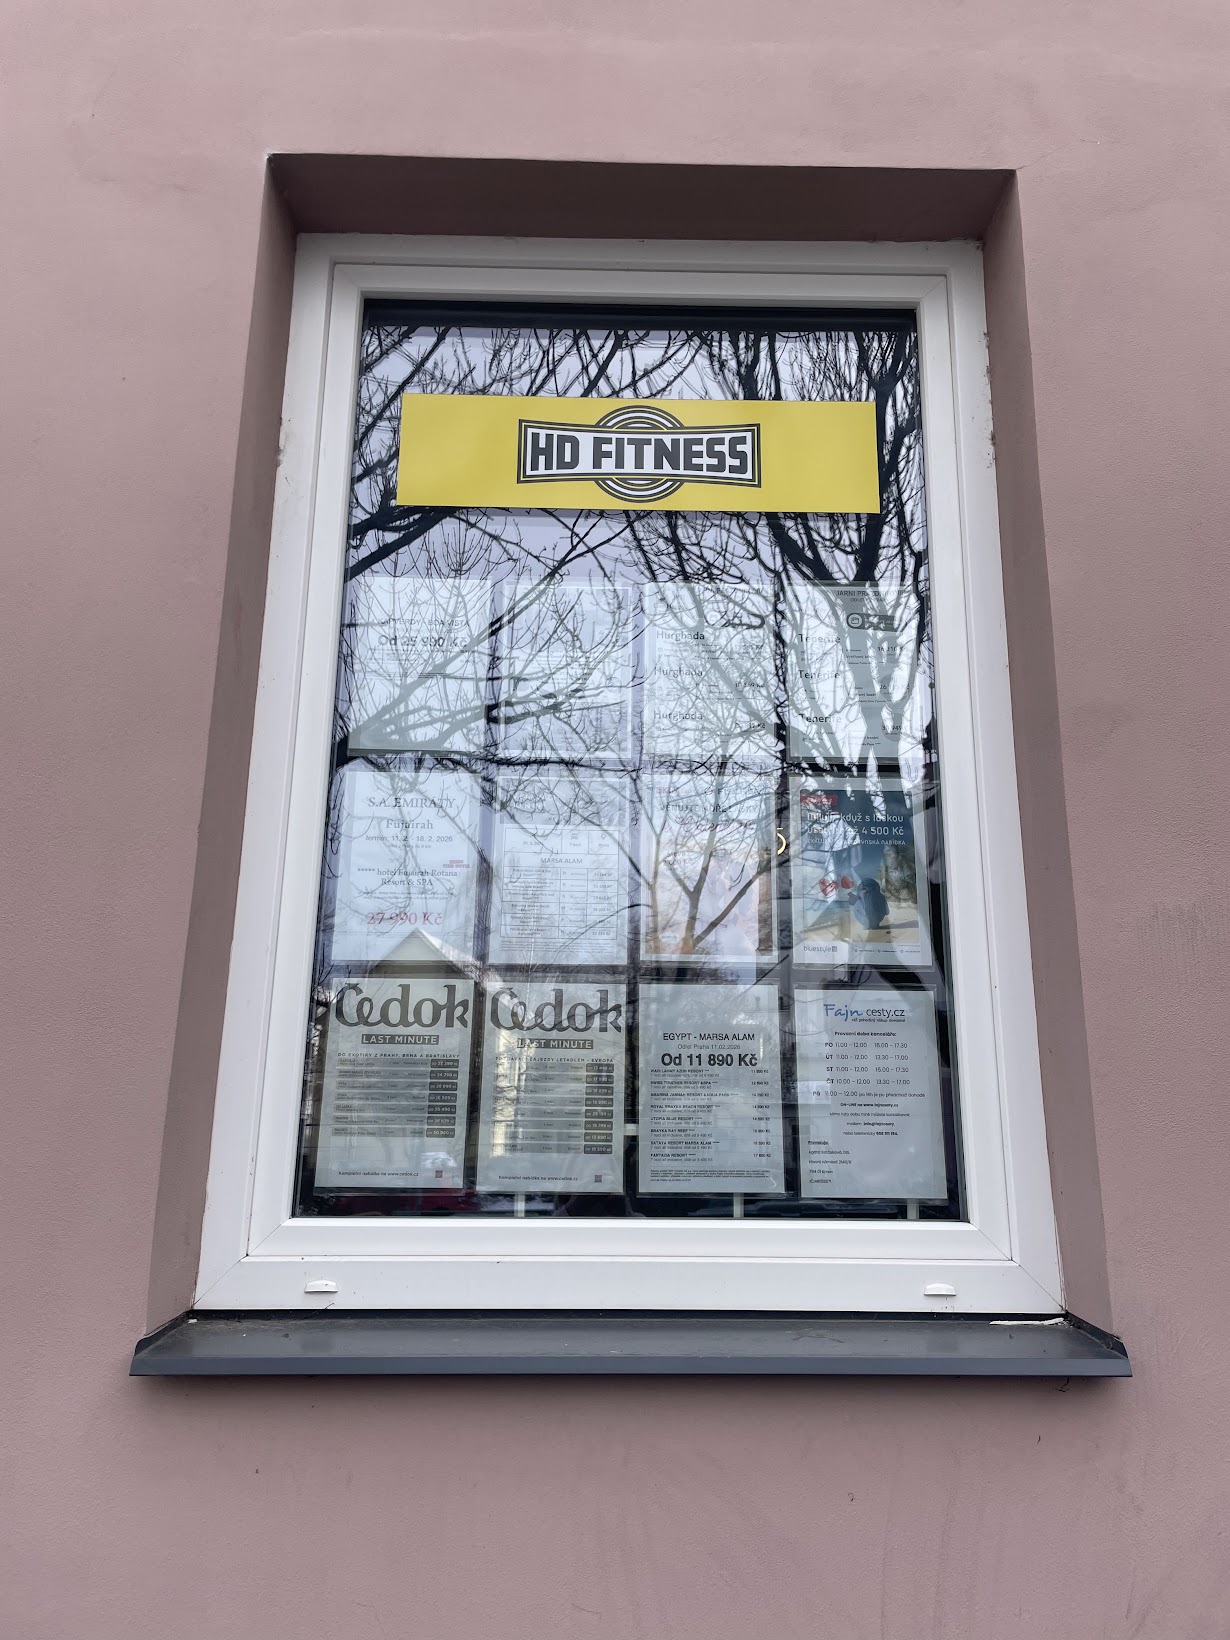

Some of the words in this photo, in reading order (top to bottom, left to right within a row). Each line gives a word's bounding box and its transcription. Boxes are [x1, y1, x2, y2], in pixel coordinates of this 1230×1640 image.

[530, 432, 580, 471] HD
[592, 435, 749, 474] FITNESS
[656, 631, 705, 641] Hurghada
[654, 666, 703, 678] Hurghada
[654, 710, 703, 721] Hurghada
[368, 797, 391, 808] S.A.
[393, 795, 456, 809] EMIRÁTY
[840, 812, 863, 823] když
[385, 819, 434, 832] Fujairah
[862, 827, 868, 835] 4
[870, 827, 889, 836] 500
[892, 826, 905, 836] Kč
[376, 868, 396, 876] hotel
[398, 868, 429, 877] Fujairah
[431, 869, 458, 877] Rotana
[381, 878, 406, 886] Resort
[416, 878, 433, 886] SPA
[367, 912, 385, 925] 27
[389, 912, 418, 926] 990
[421, 911, 443, 926] Kč
[803, 945, 832, 953] bluestyle
[823, 1003, 864, 1022] Fajn
[866, 1008, 906, 1019] cesty.cz
[362, 1035, 392, 1044] LAST
[394, 1036, 438, 1044] MINUTE
[663, 1033, 692, 1041] EGYPT
[699, 1033, 731, 1041] MARSA
[731, 1033, 755, 1041] ALAM
[517, 1040, 546, 1048] LAST
[550, 1040, 592, 1048] MINUTE
[660, 1053, 682, 1066] Od
[687, 1053, 702, 1066] 11
[707, 1053, 734, 1067] 890
[738, 1053, 758, 1067] Kč
